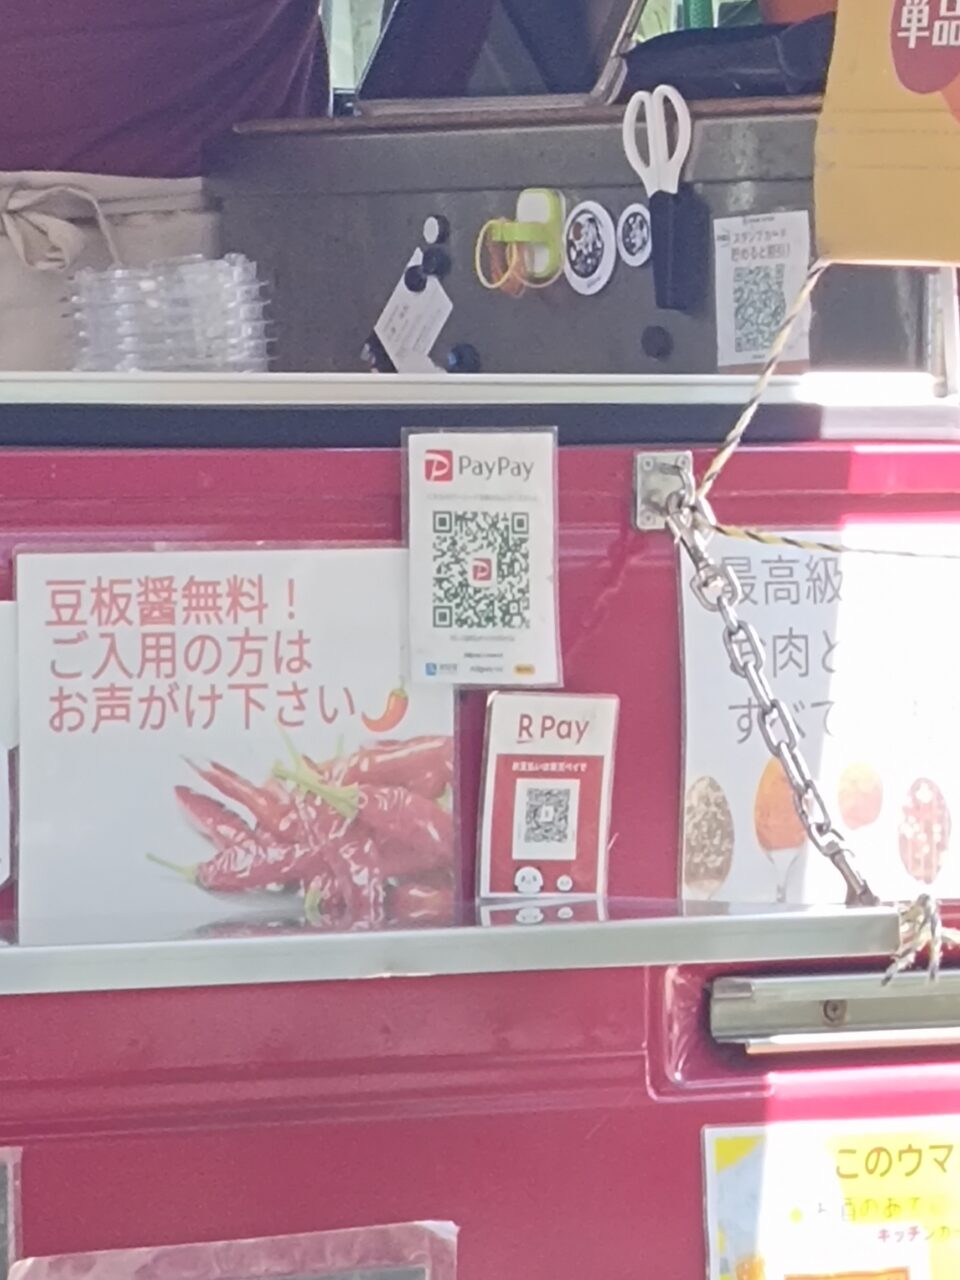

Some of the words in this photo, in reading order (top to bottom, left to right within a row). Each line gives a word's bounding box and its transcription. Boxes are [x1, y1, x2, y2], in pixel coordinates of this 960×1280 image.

[459, 455, 534, 482] PayPay
[45, 574, 296, 628] 豆板醤無料！
[50, 627, 312, 680] ご入用の方は
[48, 681, 356, 733] お声がけ下さい
[540, 715, 590, 745] Pay
[836, 1144, 954, 1178] このウマ
